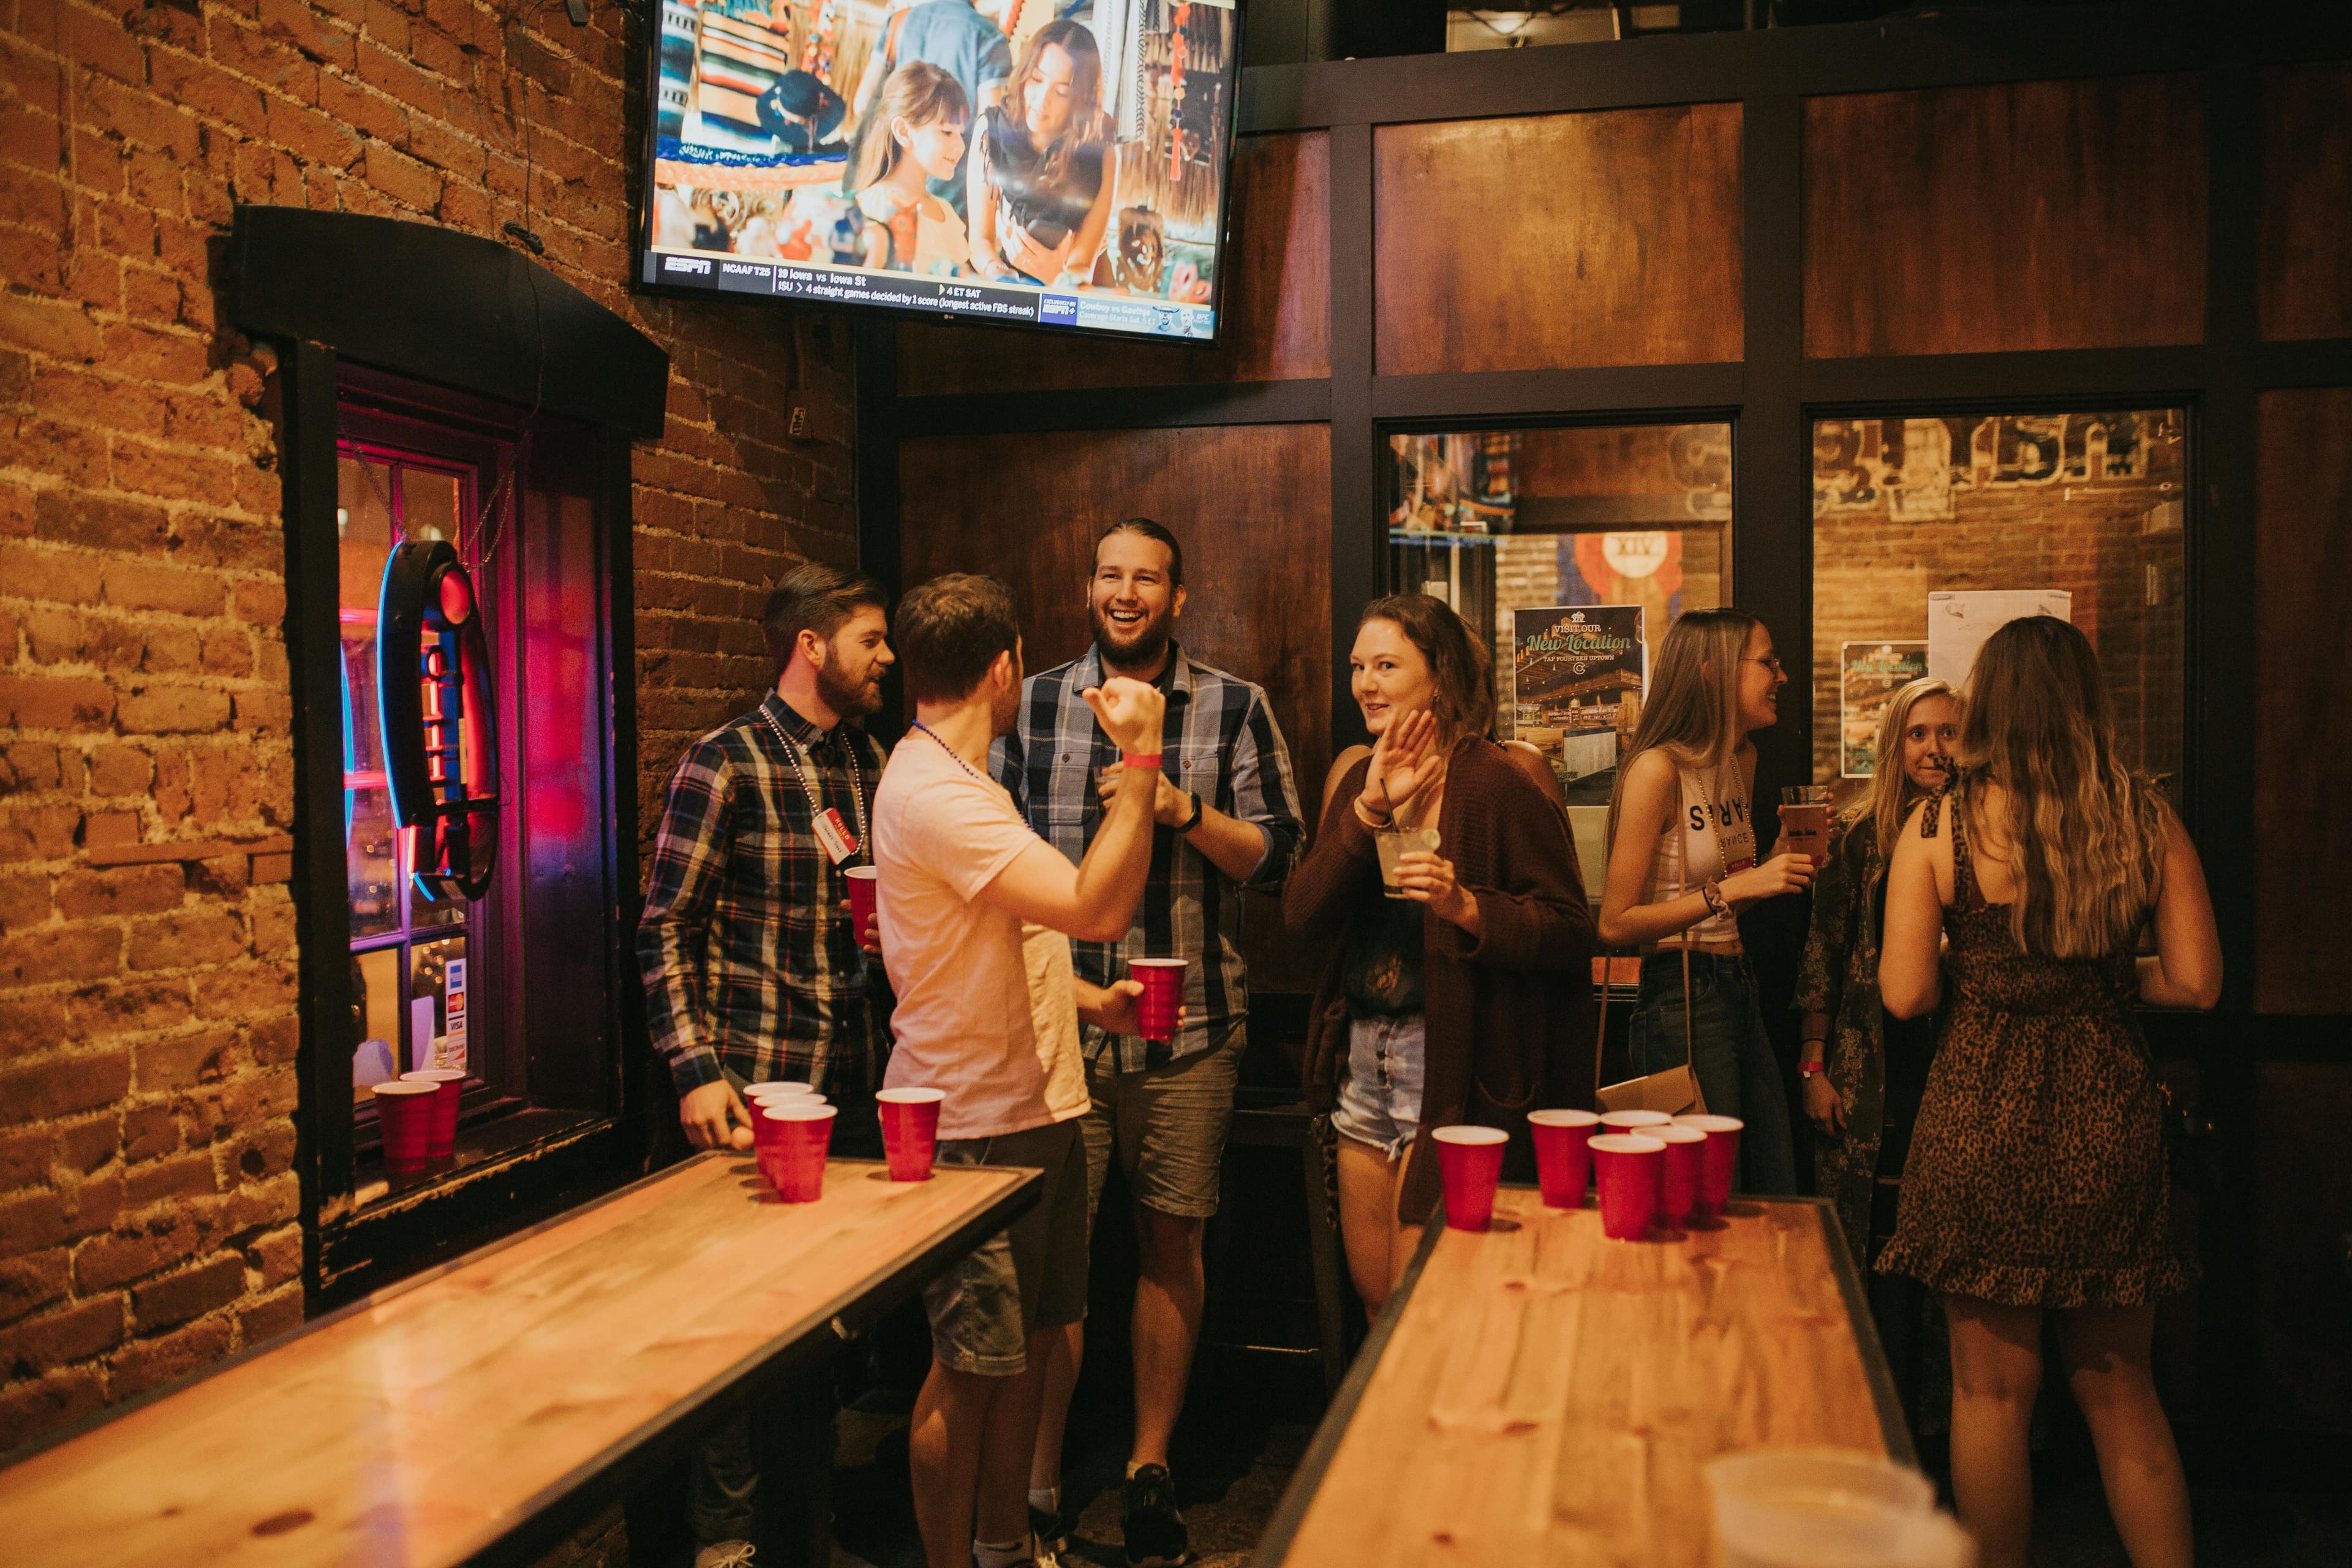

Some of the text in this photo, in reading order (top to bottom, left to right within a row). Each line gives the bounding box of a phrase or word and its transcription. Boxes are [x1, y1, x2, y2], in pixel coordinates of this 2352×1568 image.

[665, 257, 711, 274] ESPN
[722, 263, 771, 277] NCAAF T25
[777, 268, 867, 287] 19 Iowa vs Iowa St
[778, 281, 793, 292] ISU
[805, 284, 813, 294] 4
[813, 285, 843, 298] straight
[844, 289, 870, 300] games
[870, 290, 902, 304] decided
[902, 293, 912, 305] by
[911, 295, 917, 304] 1
[918, 296, 938, 306] score
[939, 298, 969, 310] (longest
[970, 301, 992, 312] active
[992, 303, 1008, 314] FBS
[946, 286, 981, 299] 4 ET SAT
[1080, 301, 1110, 314] Cowboy
[1079, 311, 1108, 322] Coverage
[1581, 624, 1602, 633] OUR
[1526, 633, 1631, 655] New Location
[450, 1021, 462, 1030] VISA
